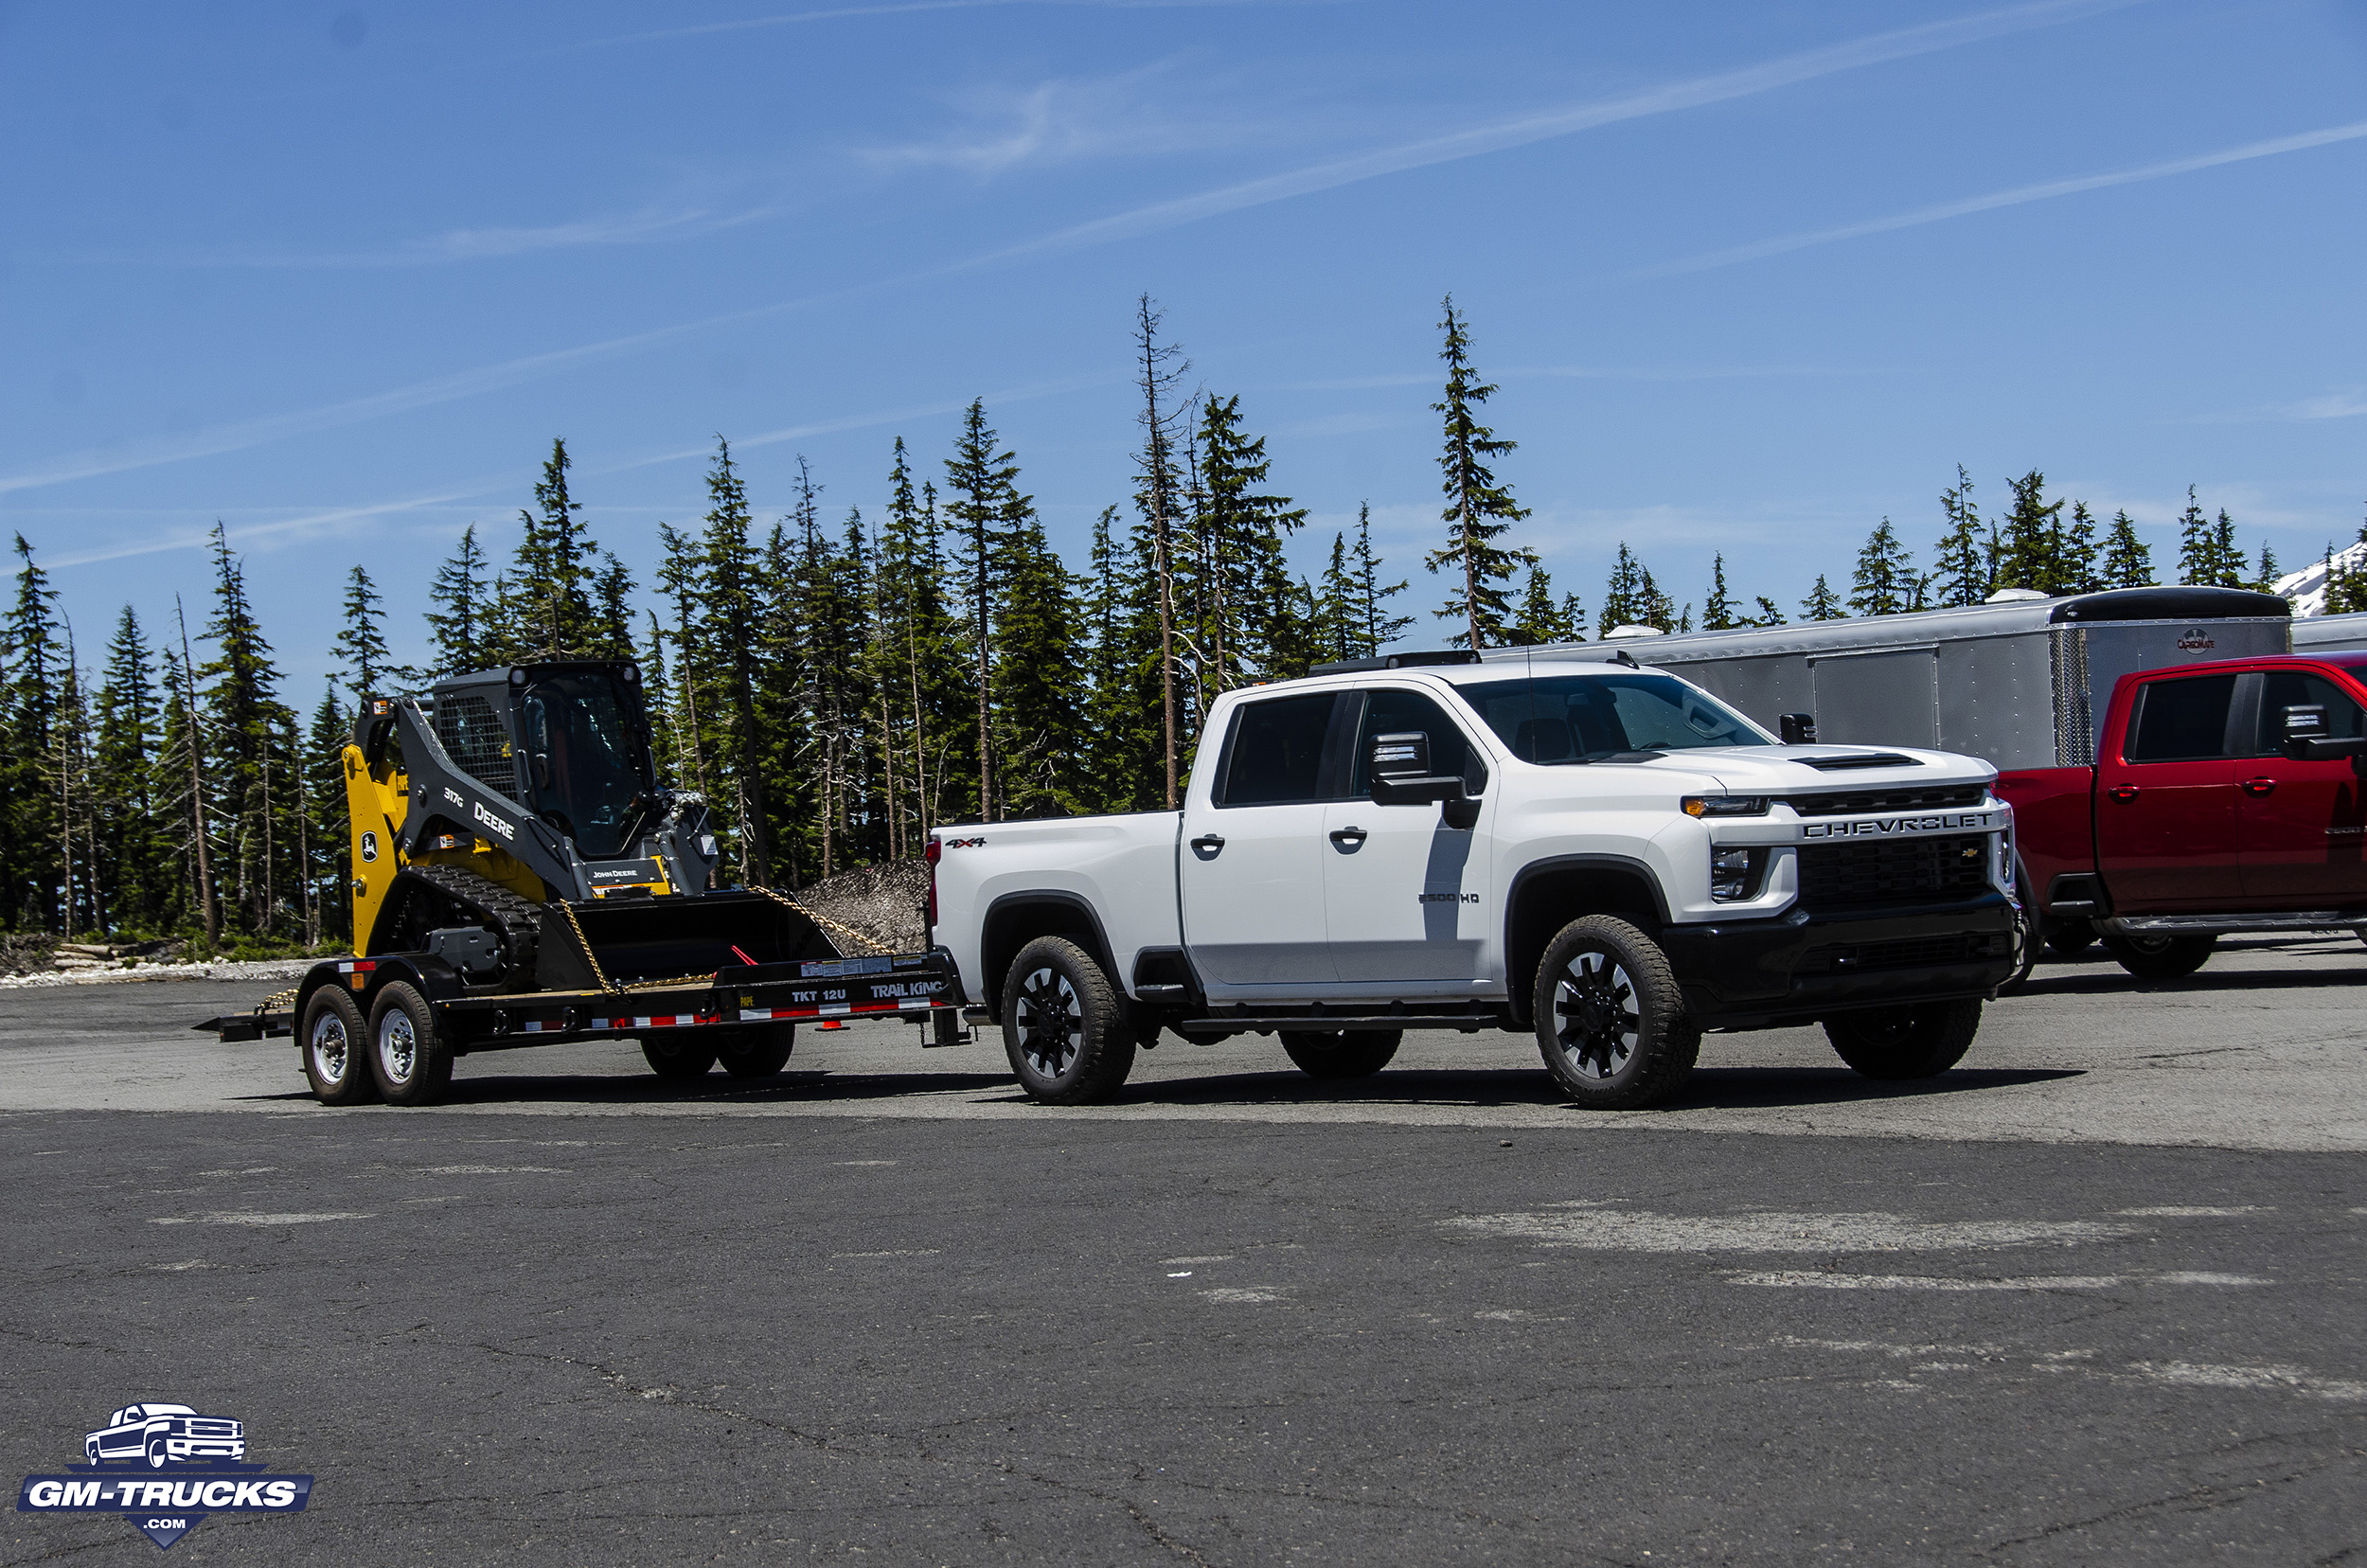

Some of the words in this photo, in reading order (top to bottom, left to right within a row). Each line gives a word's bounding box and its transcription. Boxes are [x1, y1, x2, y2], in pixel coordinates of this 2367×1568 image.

[443, 787, 464, 808] 317G
[473, 801, 515, 841] DEERE
[1803, 812, 1993, 839] CHEVROLET
[1418, 894, 1456, 903] 2500
[1460, 894, 1480, 903] HD
[792, 990, 817, 1002] TKT
[823, 989, 846, 1000] 12U
